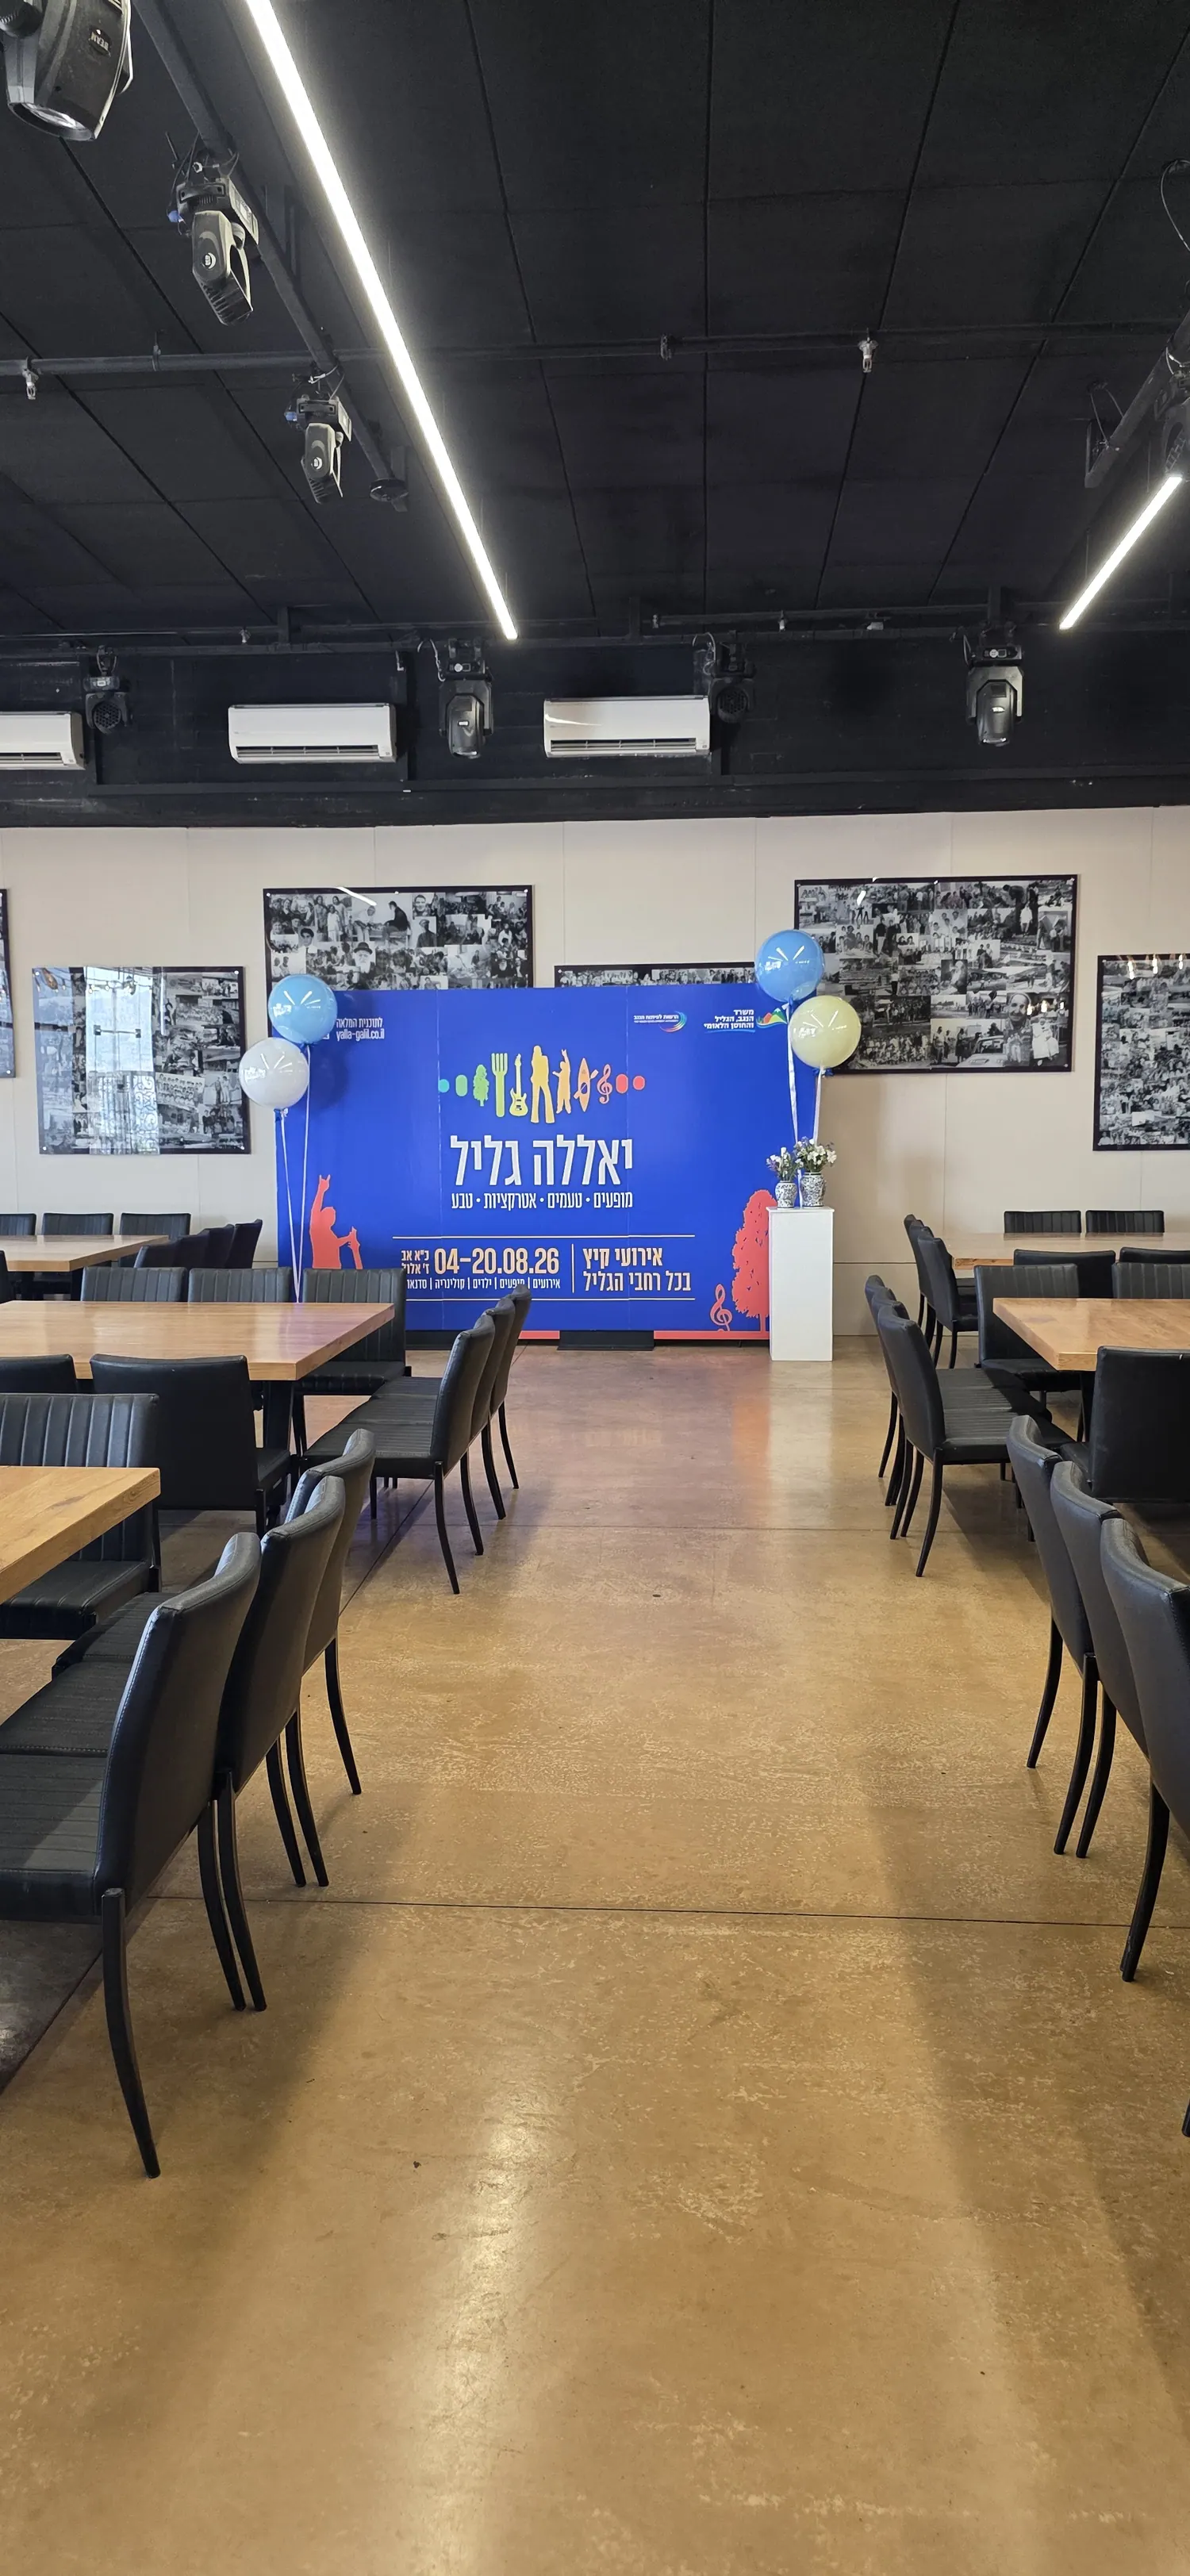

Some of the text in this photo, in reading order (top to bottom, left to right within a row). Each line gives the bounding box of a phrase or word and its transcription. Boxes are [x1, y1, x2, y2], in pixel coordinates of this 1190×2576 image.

[336, 1016, 383, 1028] לתוכנית המלאה
[336, 1028, 385, 1042] yalla-galil.co.il
[450, 1134, 633, 1186] יאללה גליל
[451, 1192, 633, 1211] מופעים טעמים אטרקציות טבע
[401, 1250, 429, 1261] כ"א אב
[434, 1247, 559, 1275] 04-20.08.26
[582, 1247, 663, 1269] אירועי קיץ
[406, 1279, 428, 1290] סדנאו
[435, 1277, 465, 1291] קולינריה
[473, 1277, 492, 1289] ילדים
[532, 1278, 561, 1289] אירועים
[583, 1270, 691, 1292] בכל רחבי הגליל
